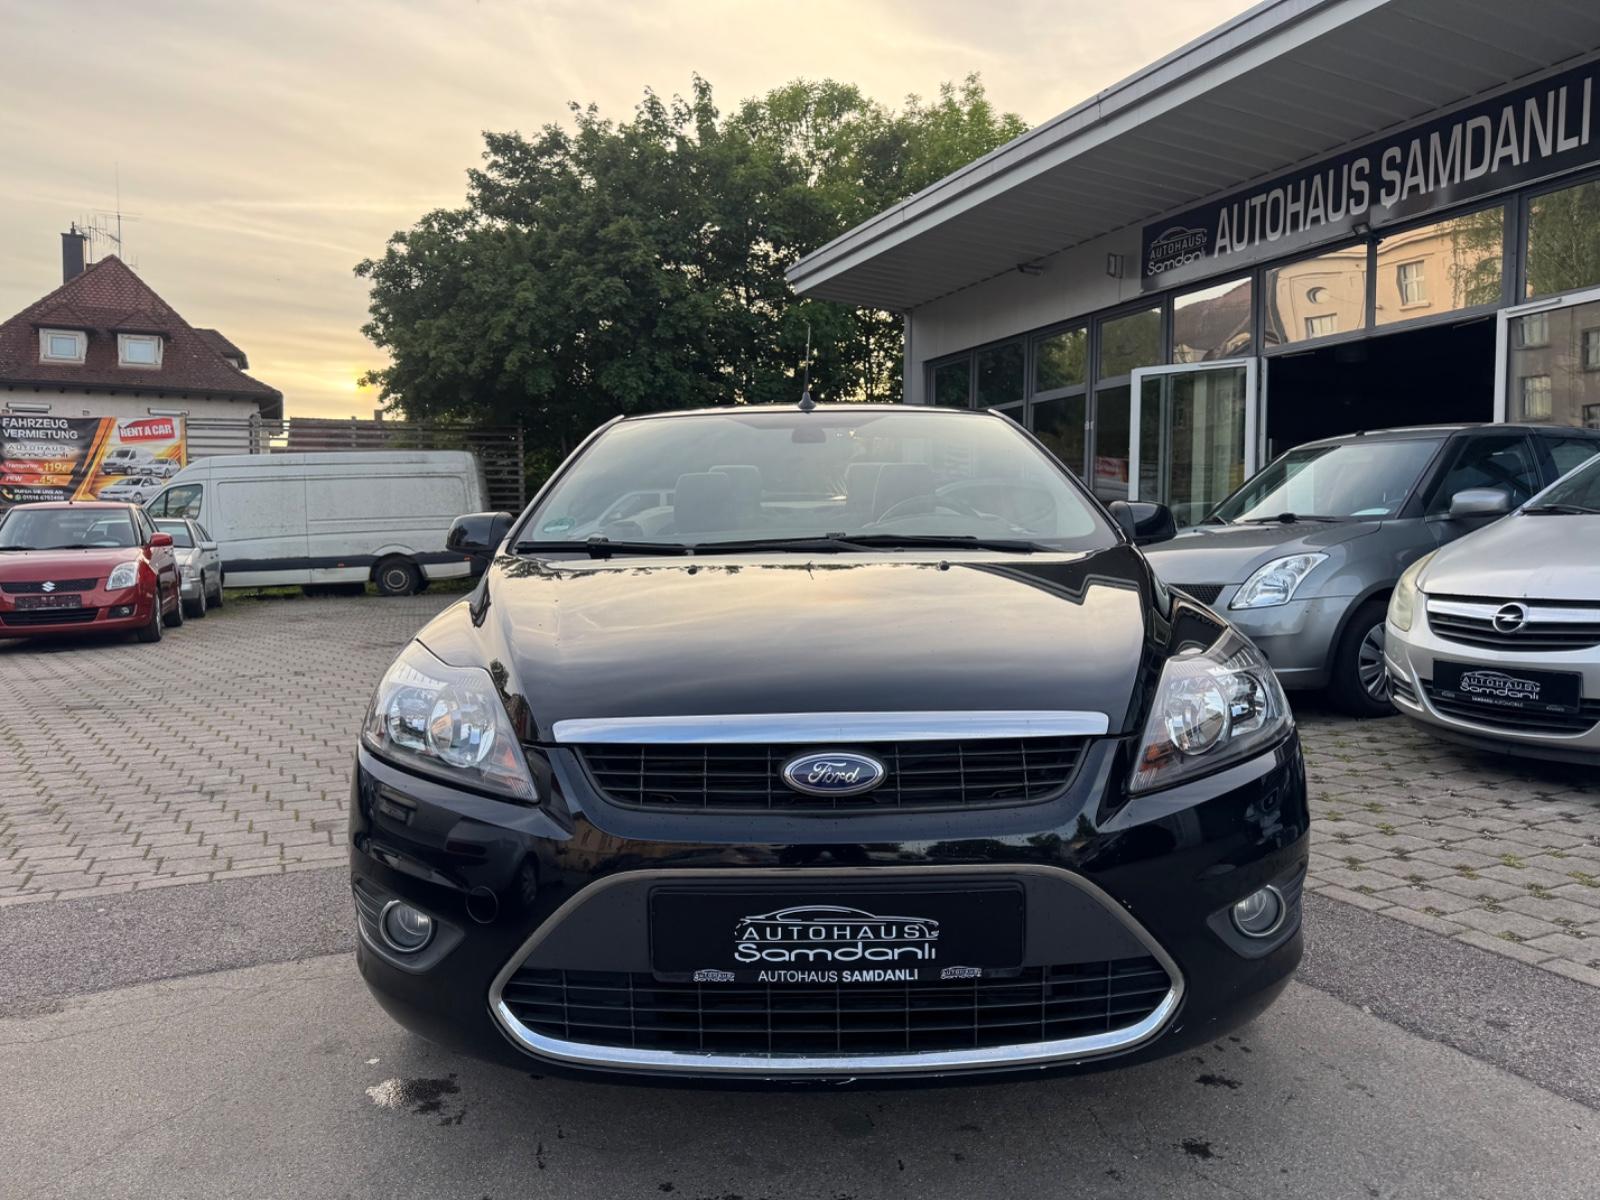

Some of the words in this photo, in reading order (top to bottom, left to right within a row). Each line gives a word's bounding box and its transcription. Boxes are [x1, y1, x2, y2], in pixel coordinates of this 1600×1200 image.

[1213, 157, 1370, 259] AUTOHAUS
[1150, 232, 1202, 260] AUTOHAUS
[2, 417, 68, 429] FAHRZEUG
[120, 426, 143, 437] RENT
[144, 425, 152, 436] A
[152, 424, 172, 435] CAR
[3, 428, 78, 439] VERMIETUNG
[1463, 677, 1534, 692] AUTOHAUS
[808, 761, 860, 784] Ford
[742, 924, 920, 941] AUTOHAUS
[758, 970, 838, 983] AUTOHAUS
[842, 969, 919, 982] SAMDANLI
